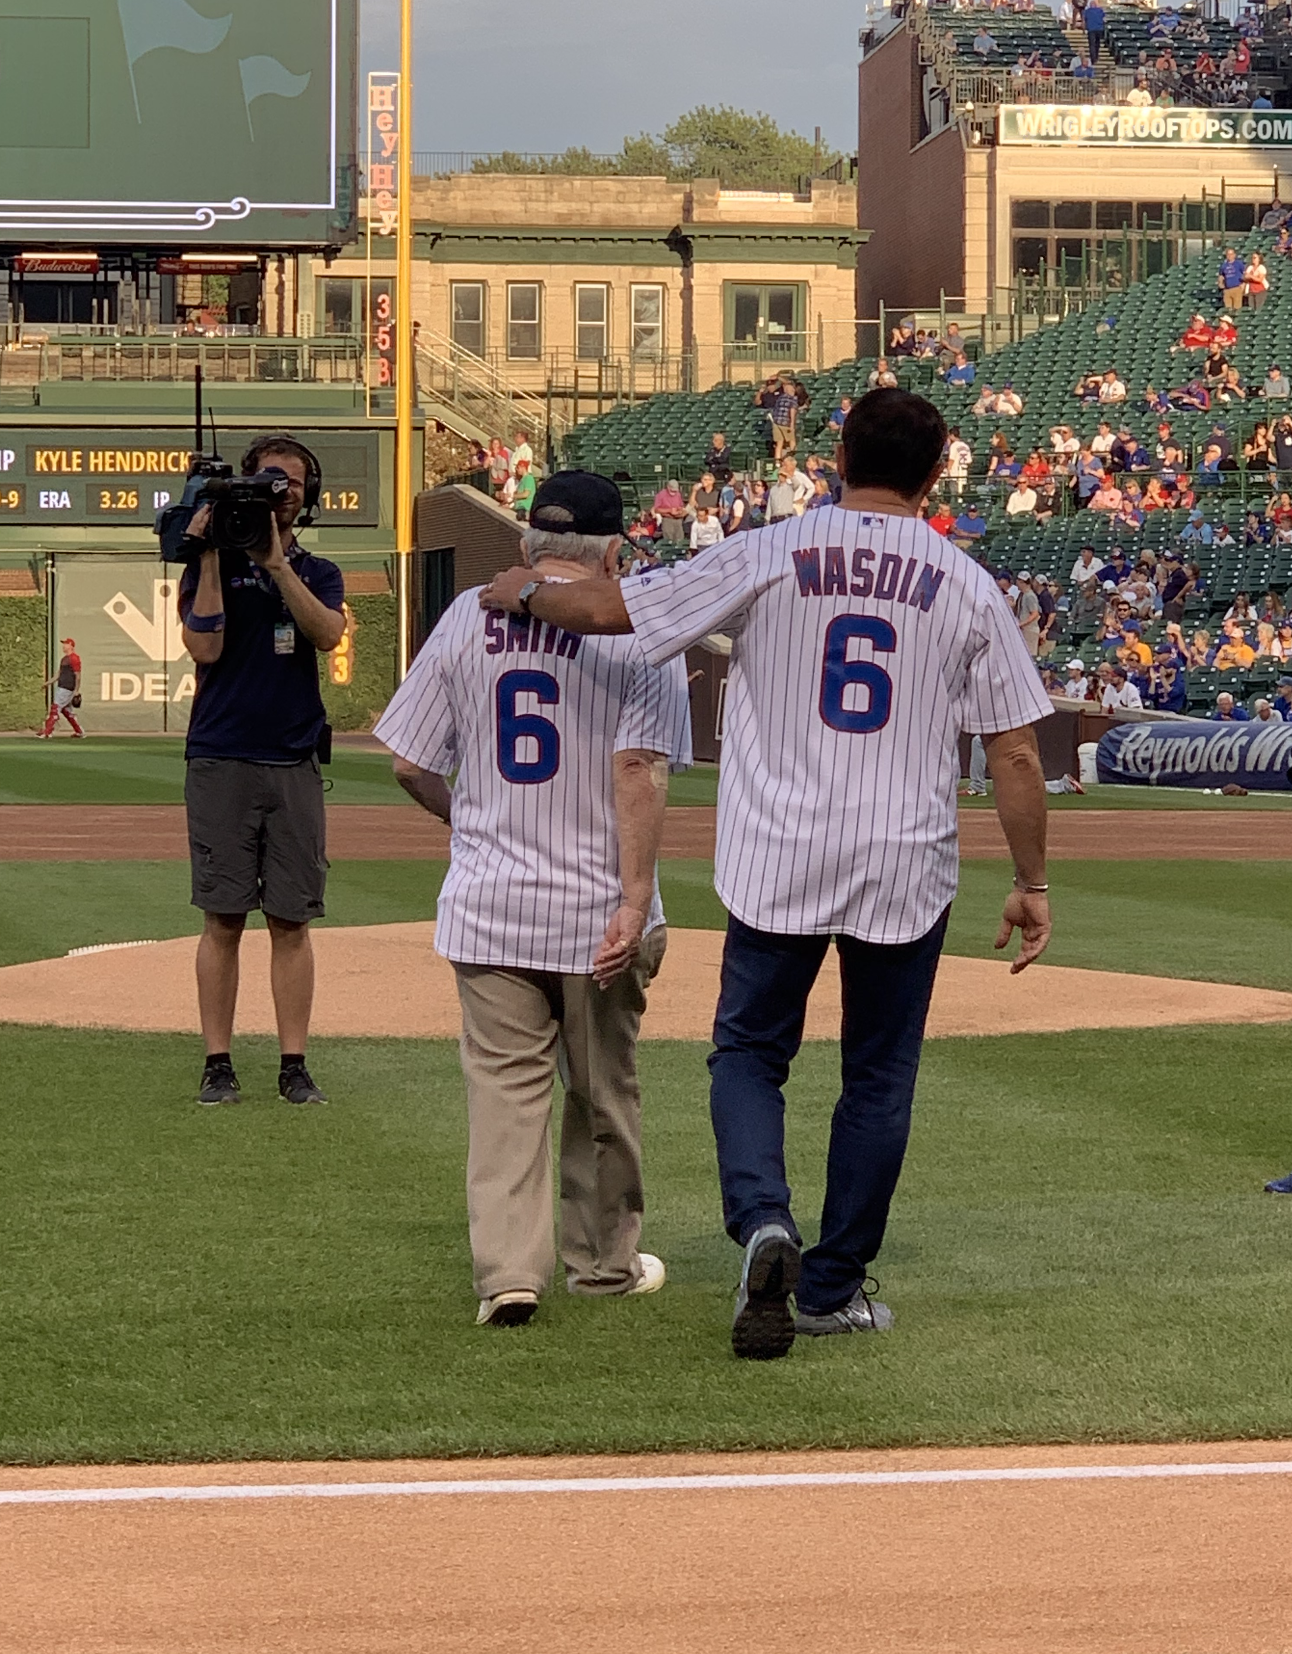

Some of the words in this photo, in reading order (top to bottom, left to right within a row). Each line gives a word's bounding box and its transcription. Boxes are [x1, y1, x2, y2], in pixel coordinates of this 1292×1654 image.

[370, 85, 399, 158] Hey
[1016, 111, 1292, 140] WRIGLEYROOFTOPS.COM
[370, 164, 399, 235] Hey
[22, 258, 91, 273] Budweiser
[35, 451, 82, 472] KYLE
[39, 490, 71, 509] ERA
[100, 490, 138, 509] 3.26
[153, 491, 170, 509] IP
[322, 491, 359, 510] 1.12
[792, 546, 946, 613] WASDIN
[818, 613, 897, 735] 6
[496, 669, 560, 784] 6
[1112, 725, 1250, 785] Reynolds
[1245, 725, 1292, 772] Wr
